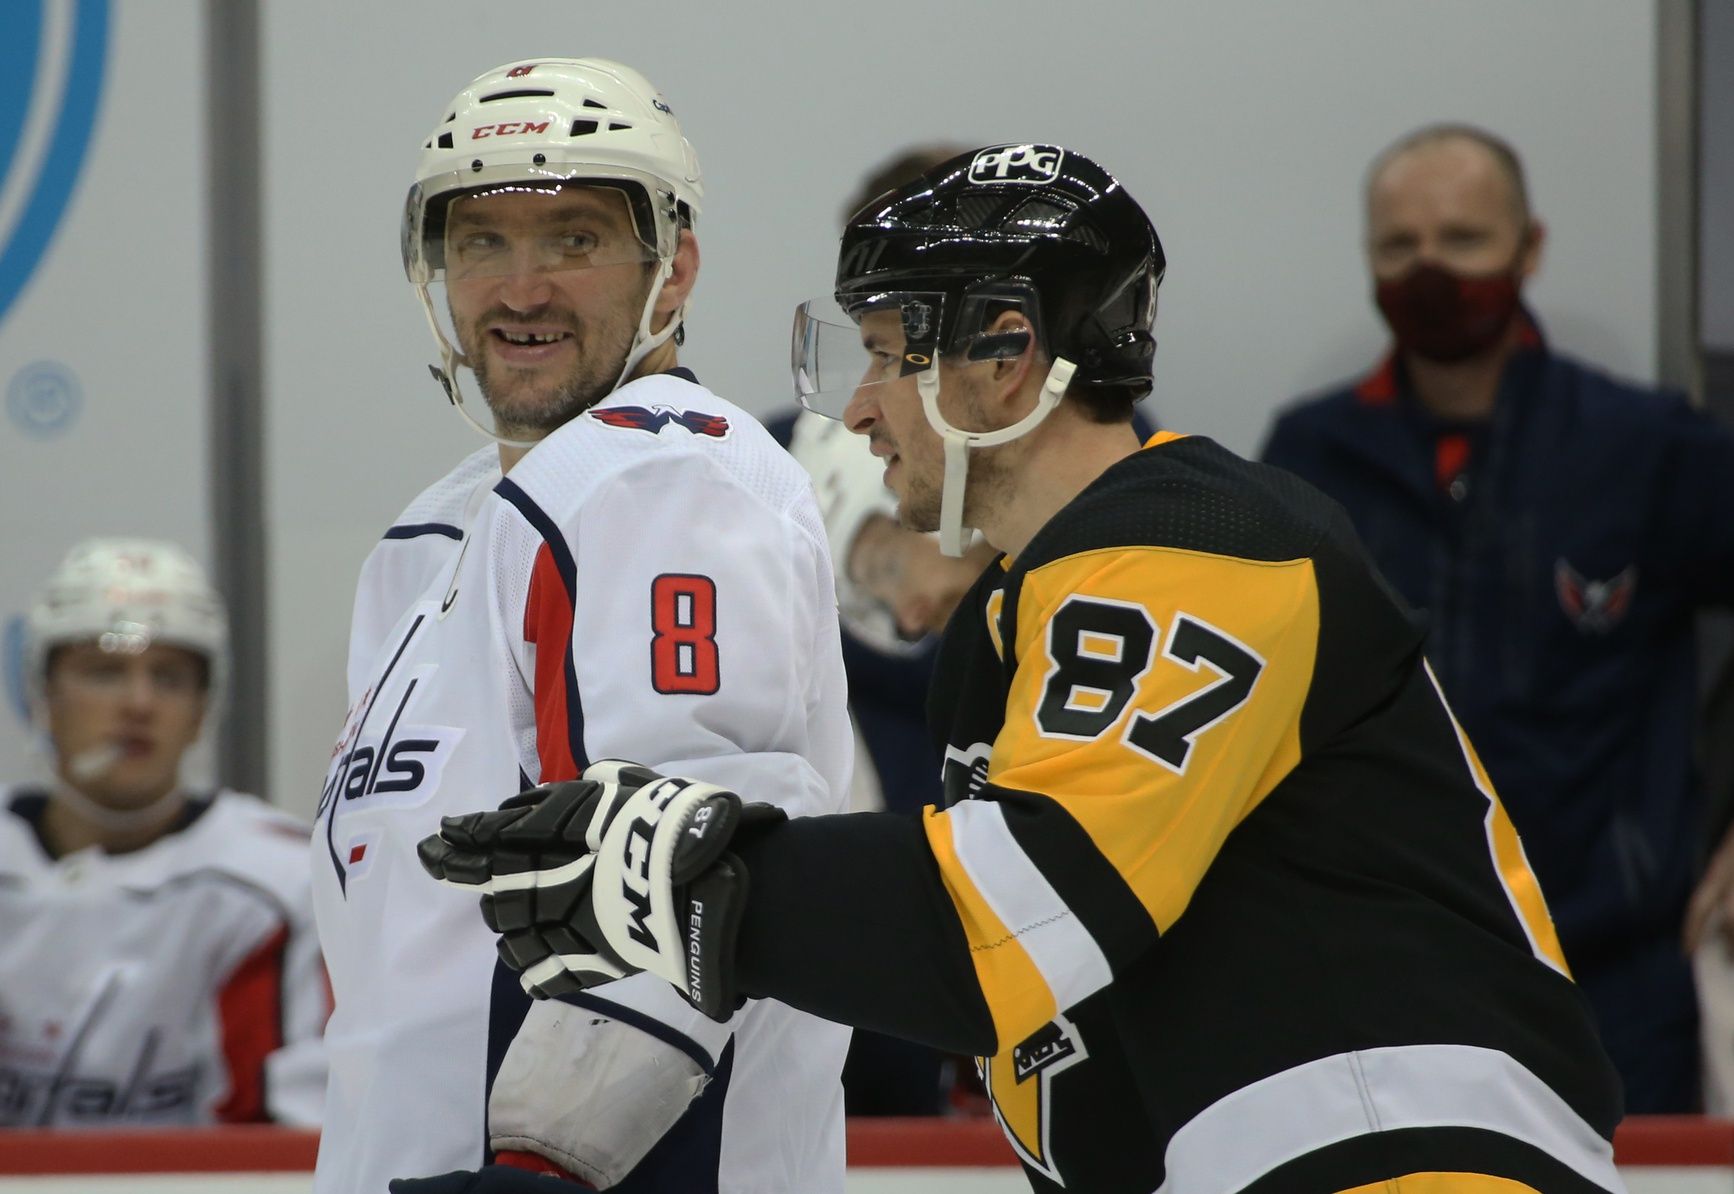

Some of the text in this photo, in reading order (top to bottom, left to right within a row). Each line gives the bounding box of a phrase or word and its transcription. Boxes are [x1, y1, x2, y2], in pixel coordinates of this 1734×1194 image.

[471, 122, 549, 139] CCM
[975, 144, 1057, 177] PPG
[651, 573, 720, 696] 8
[1032, 592, 1268, 777] 87
[623, 777, 690, 954] CCM
[688, 806, 713, 839] 87
[690, 899, 704, 1003] PENGUINS
